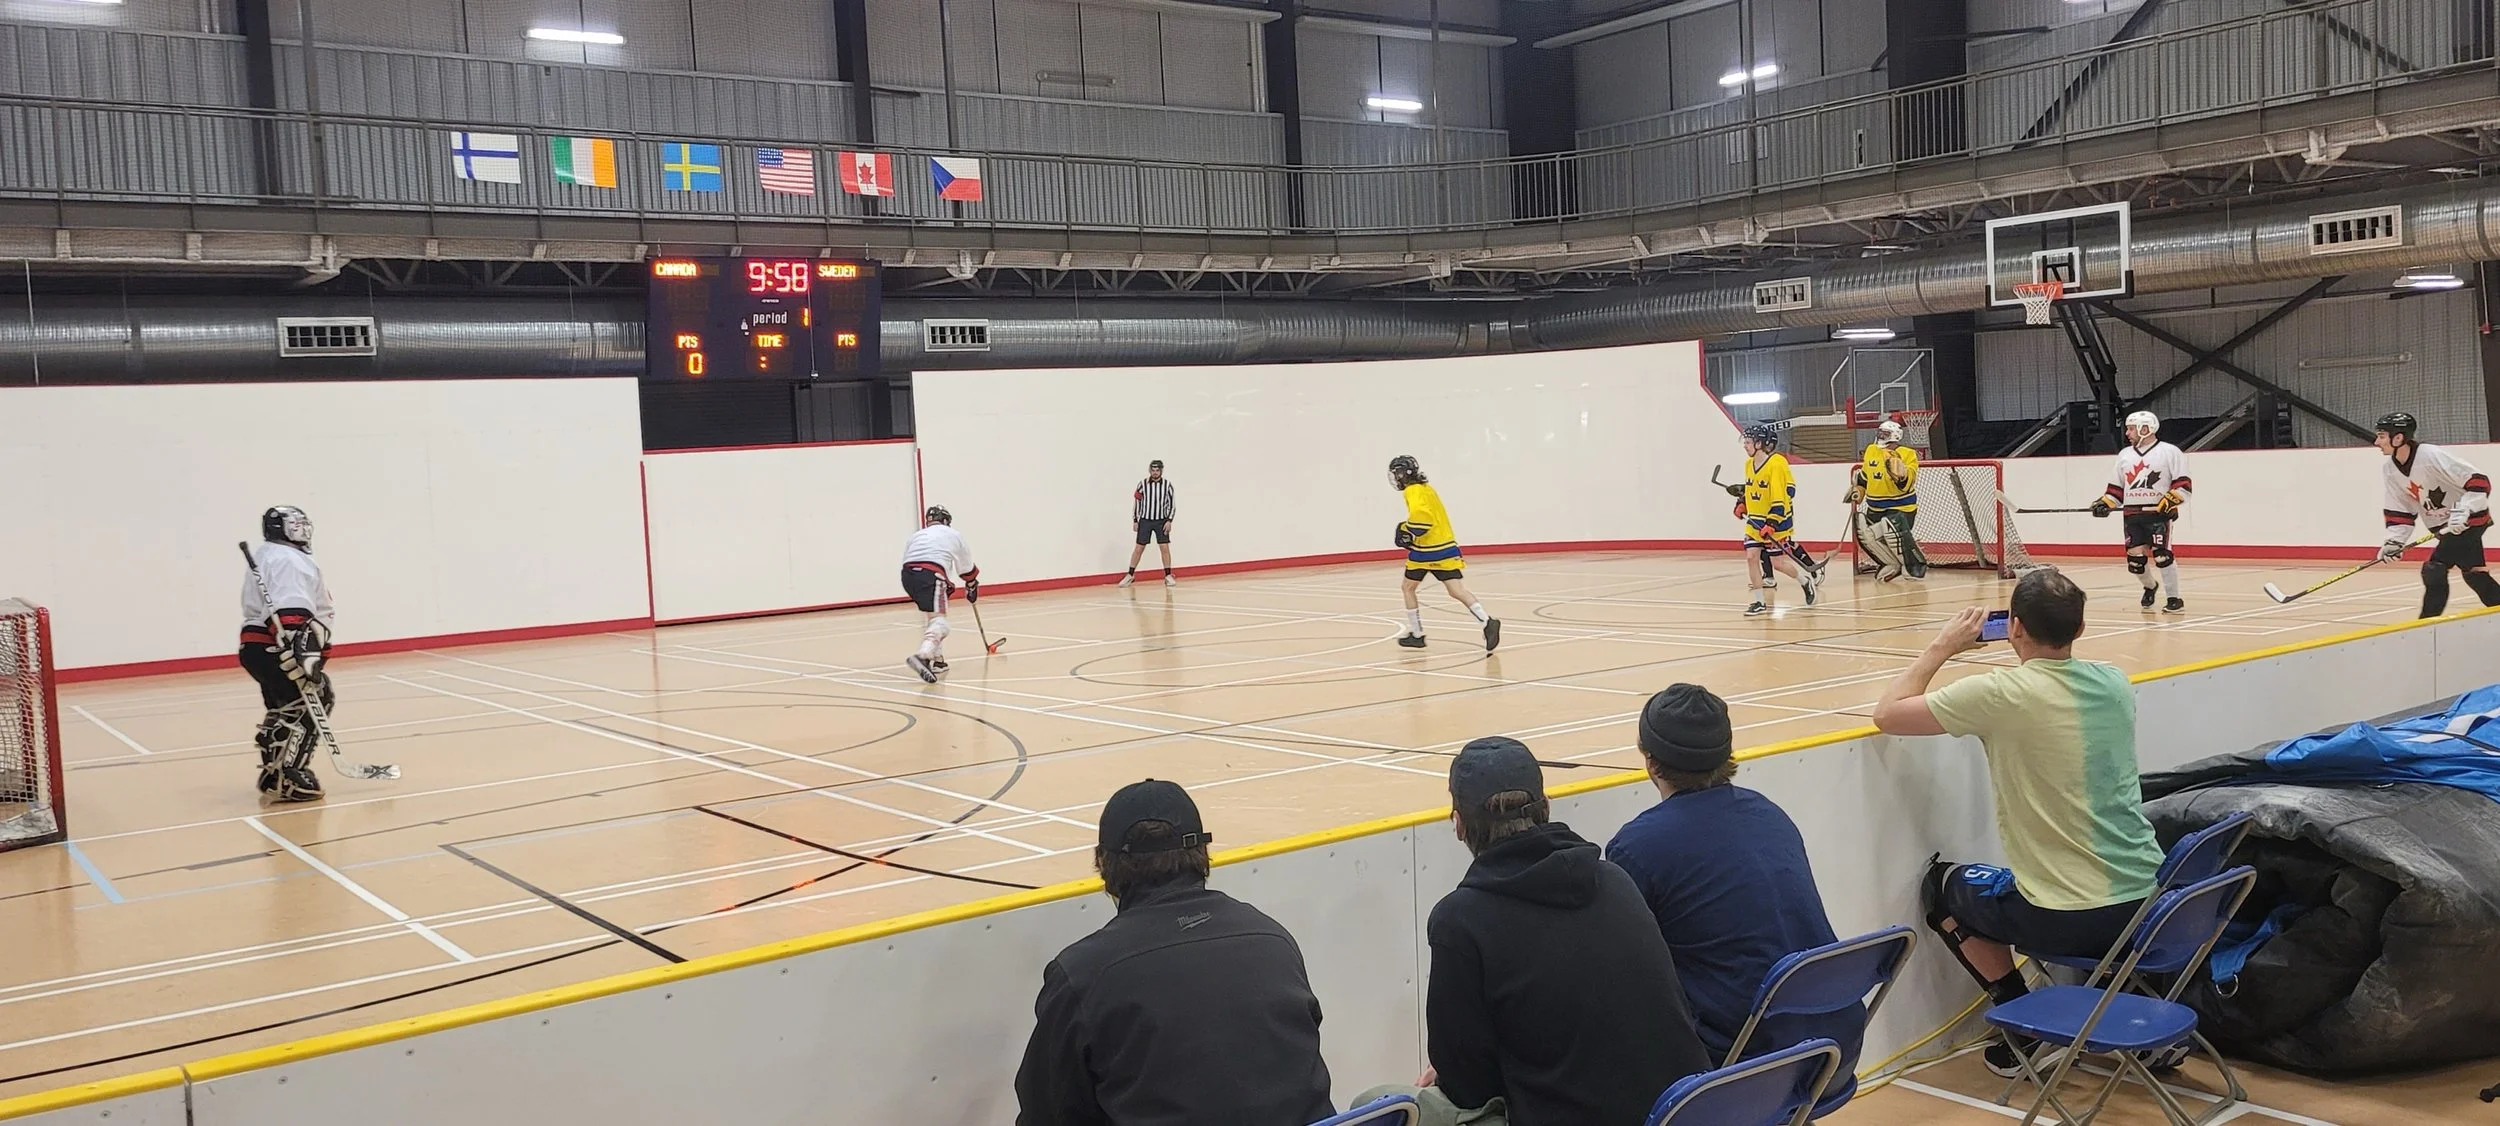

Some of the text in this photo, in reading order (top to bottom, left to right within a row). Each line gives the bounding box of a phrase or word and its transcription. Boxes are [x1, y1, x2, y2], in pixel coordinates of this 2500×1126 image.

[655, 263, 697, 276] CANADA
[818, 264, 857, 278] SWEDEN
[748, 262, 808, 292] 9:58
[752, 311, 788, 327] period
[677, 335, 699, 348] PTS
[757, 334, 783, 348] TIME
[837, 334, 857, 347] PTS
[688, 353, 703, 374] 0
[2152, 533, 2164, 545] 12
[305, 692, 341, 756] BAUER
